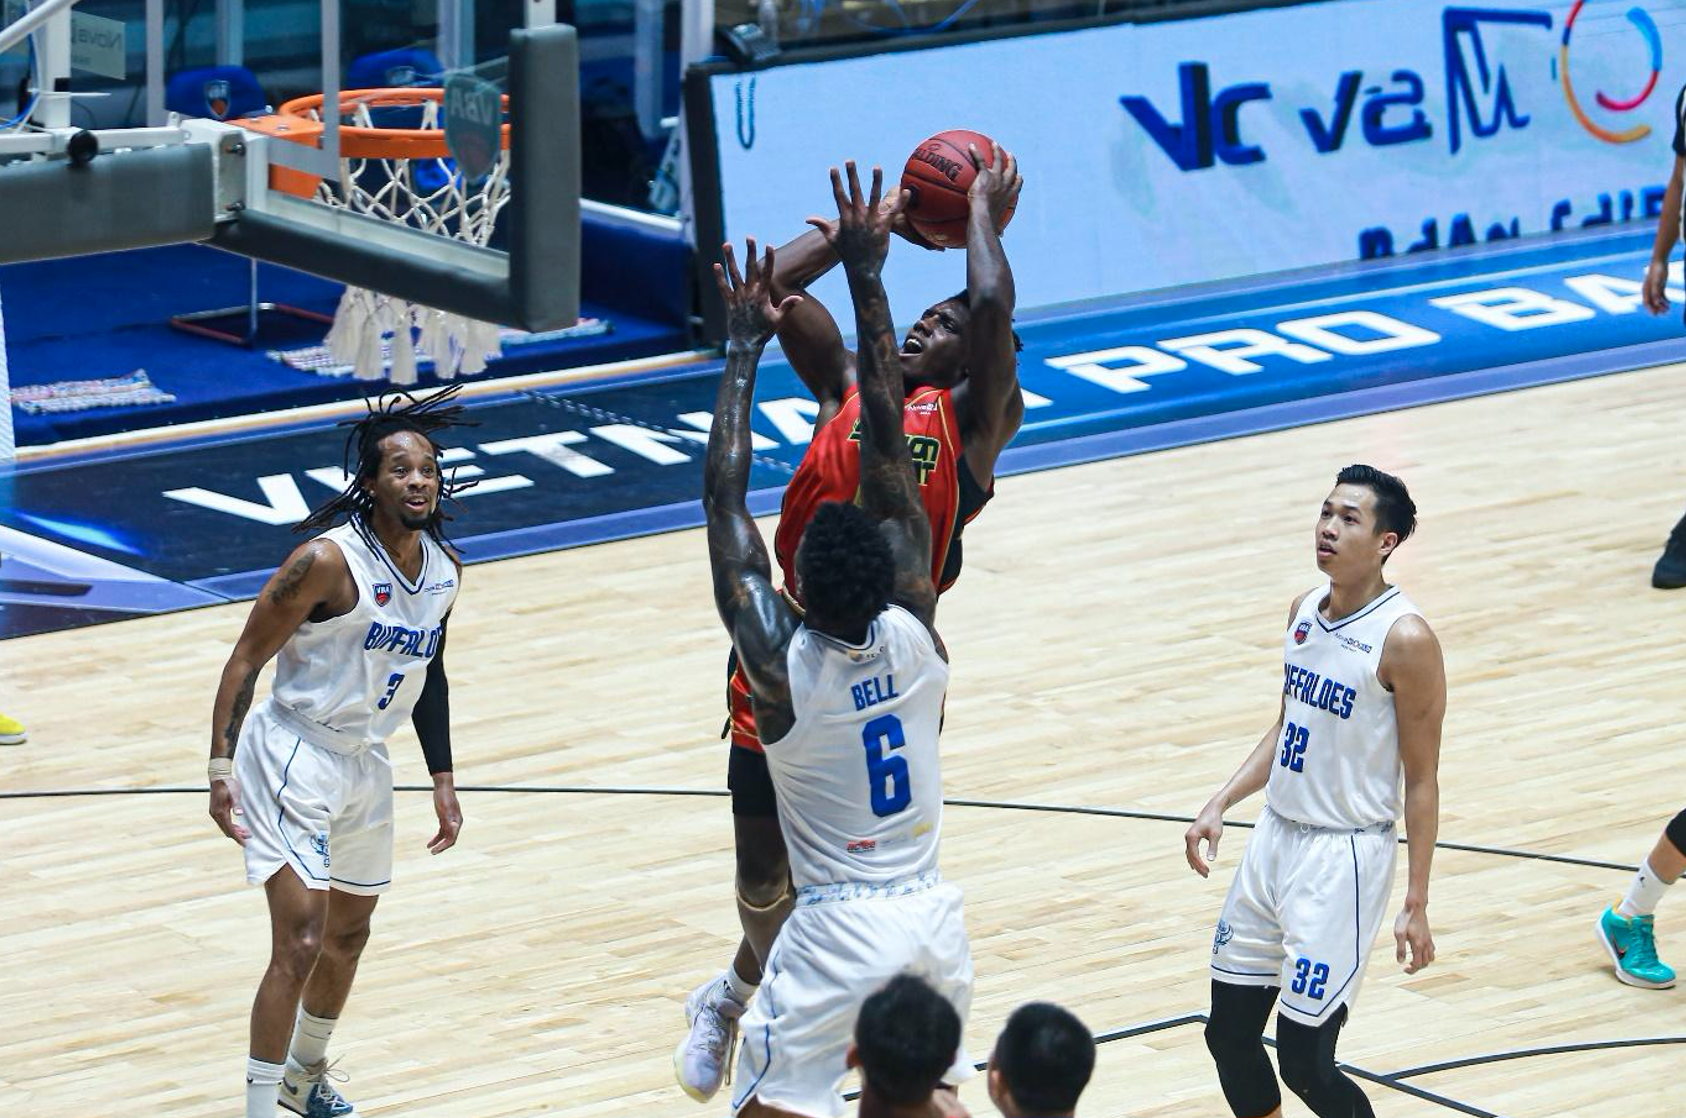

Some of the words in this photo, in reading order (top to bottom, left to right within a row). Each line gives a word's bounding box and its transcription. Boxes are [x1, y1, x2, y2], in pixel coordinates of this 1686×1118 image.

[1045, 309, 1442, 394] PRO
[1428, 260, 1682, 332] BA
[363, 620, 444, 659] BUFFALO
[378, 672, 405, 710] 3
[851, 674, 899, 711] BELL
[862, 713, 912, 818] 6
[1280, 721, 1310, 773] 32
[1291, 957, 1330, 1001] 32
